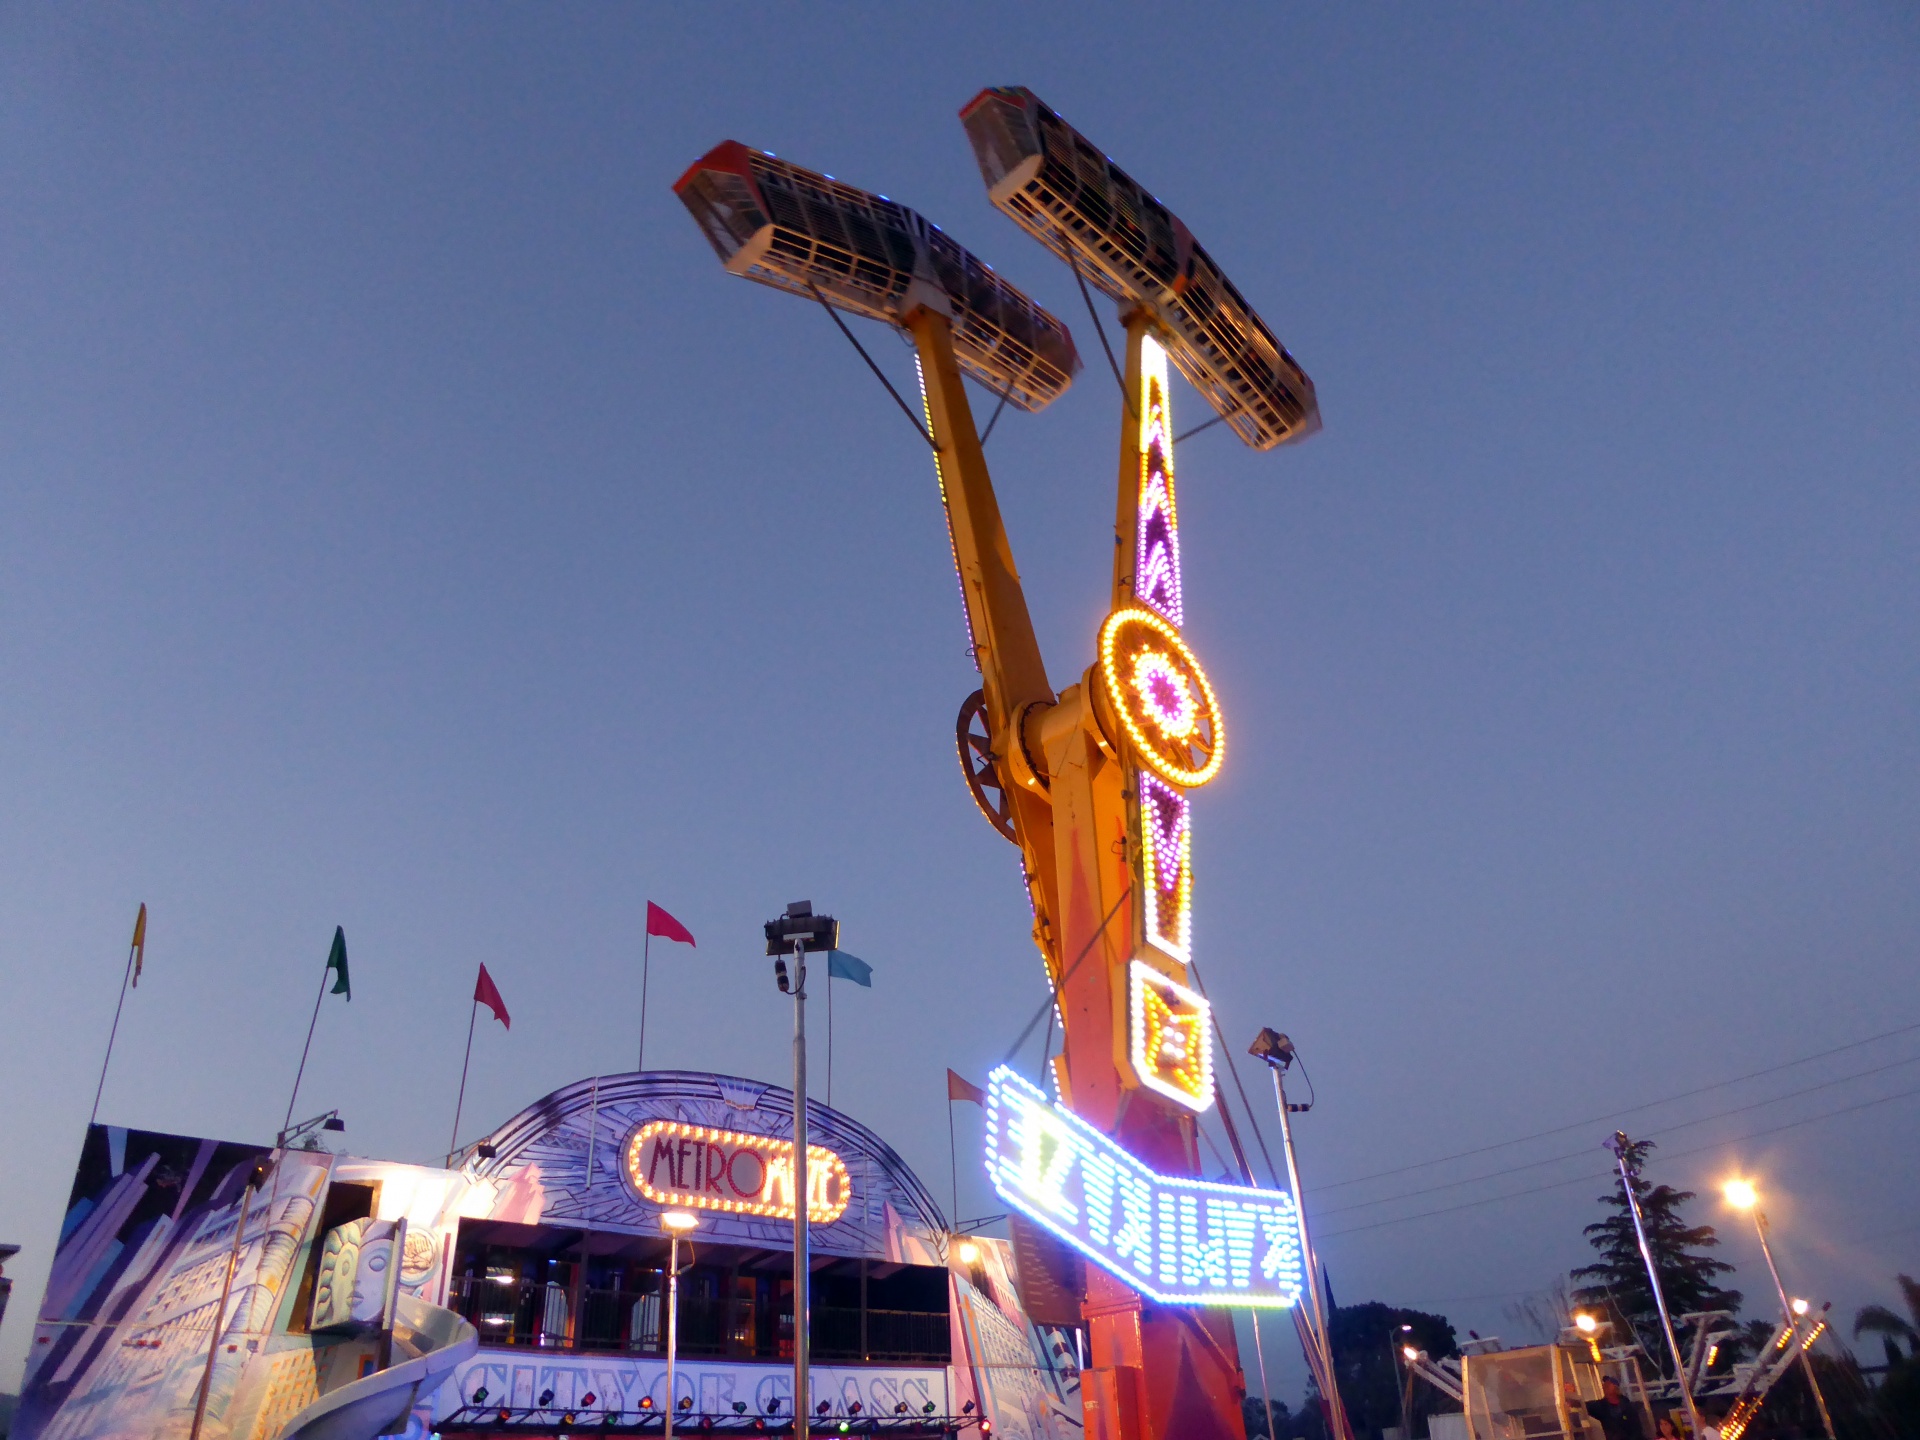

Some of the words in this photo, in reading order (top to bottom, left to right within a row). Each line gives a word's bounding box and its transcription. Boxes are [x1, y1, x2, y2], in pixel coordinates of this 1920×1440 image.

[463, 1363, 638, 1418] CITY
[650, 1370, 737, 1420] OF
[756, 1374, 931, 1423] GLASS
